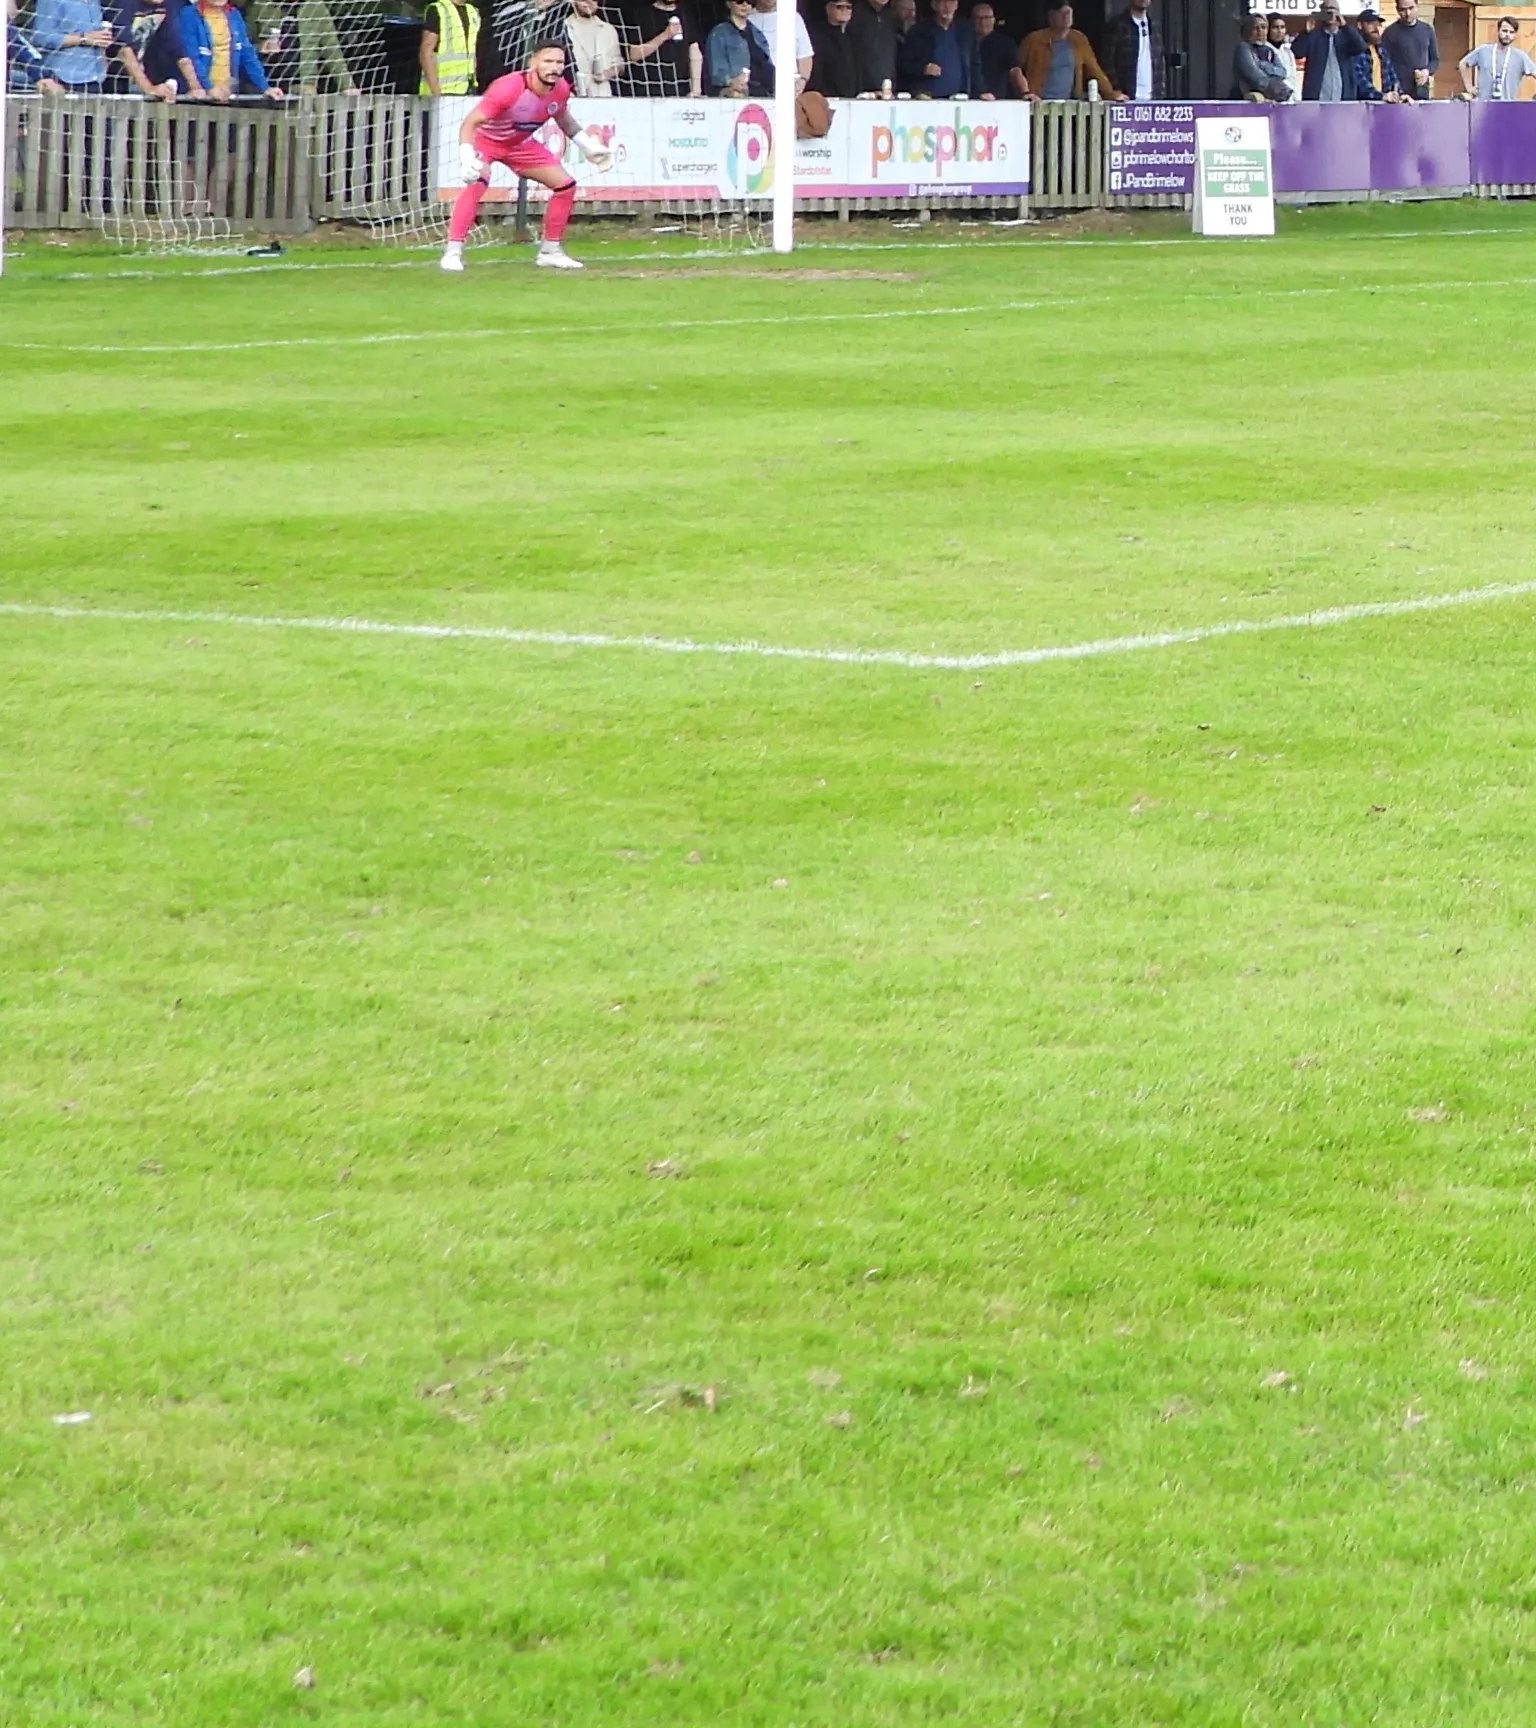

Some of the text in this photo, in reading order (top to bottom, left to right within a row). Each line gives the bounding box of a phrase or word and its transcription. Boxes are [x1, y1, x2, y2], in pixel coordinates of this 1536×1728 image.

[1134, 106, 1152, 122] 0161
[1154, 106, 1171, 122] 882
[1173, 106, 1193, 122] 2233
[1207, 172, 1265, 182] KEEP OFF THE
[1223, 183, 1251, 193] GRASS
[1224, 204, 1253, 214] THANK
[1230, 216, 1248, 226] YOU
